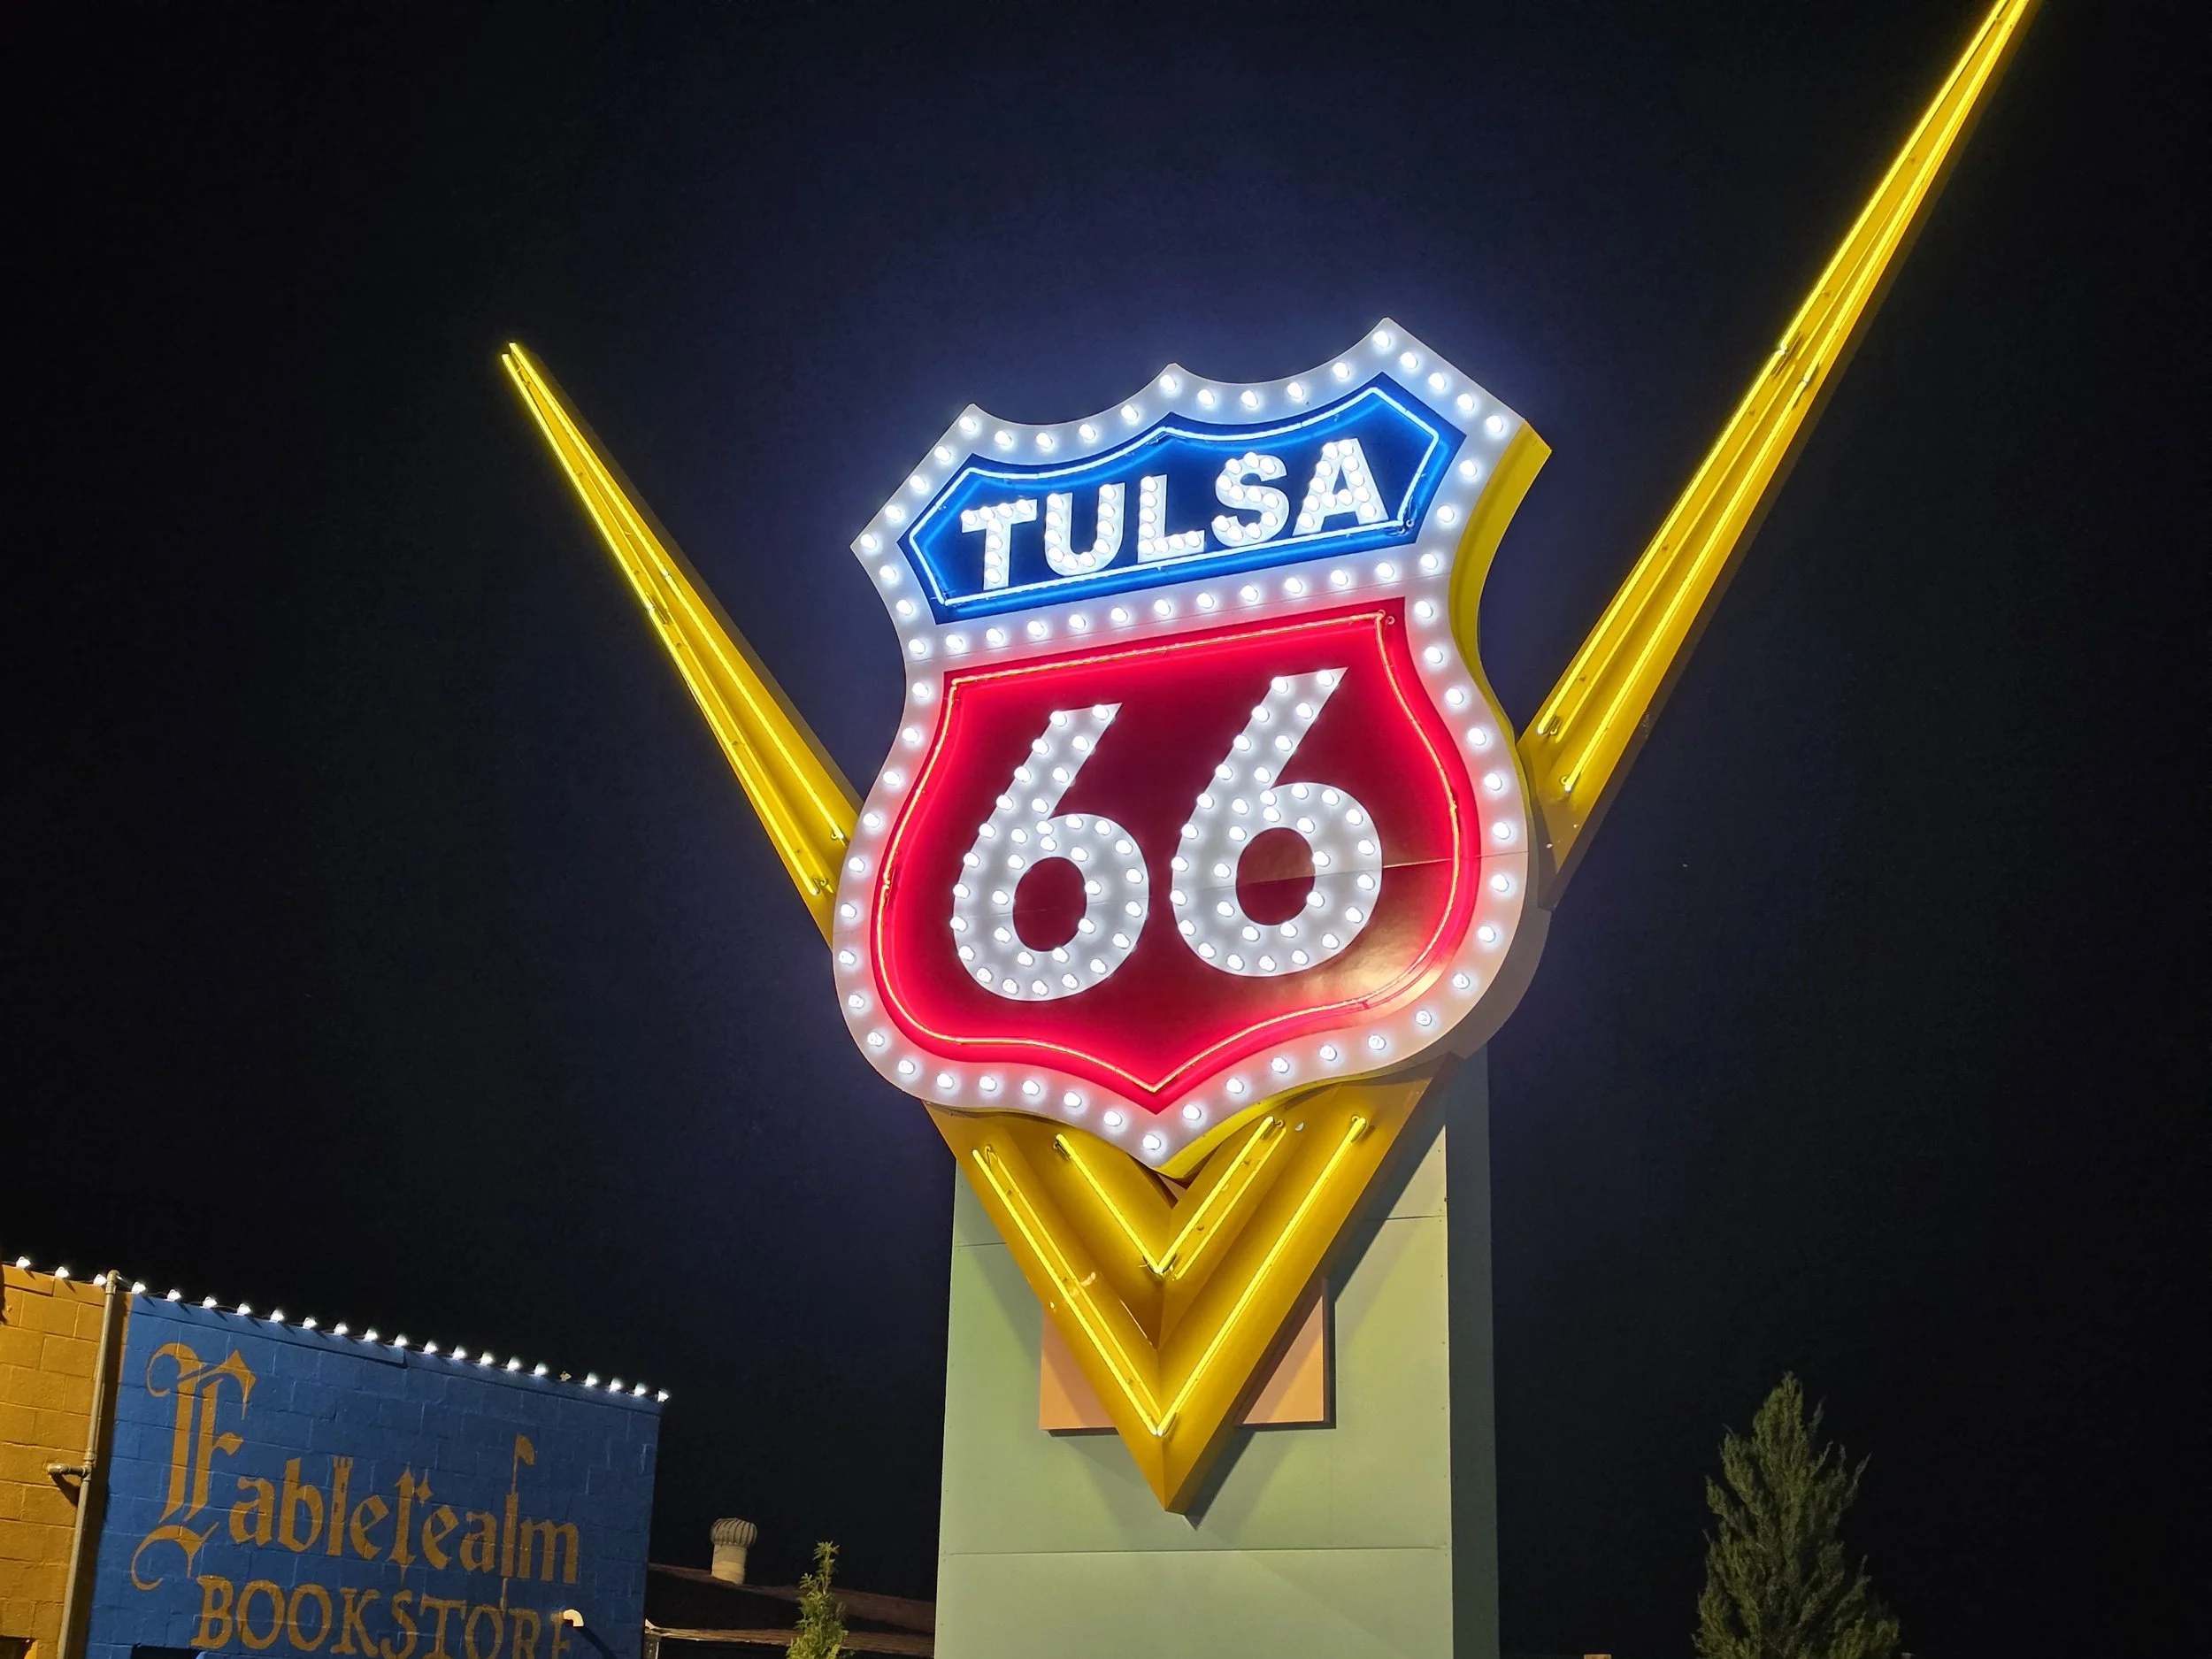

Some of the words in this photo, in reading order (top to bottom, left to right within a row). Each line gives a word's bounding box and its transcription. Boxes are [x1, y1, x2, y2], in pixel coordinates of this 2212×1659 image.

[961, 437, 1389, 591] TULSA
[951, 667, 1384, 1002] 66
[132, 1343, 580, 1590] Fablerealm
